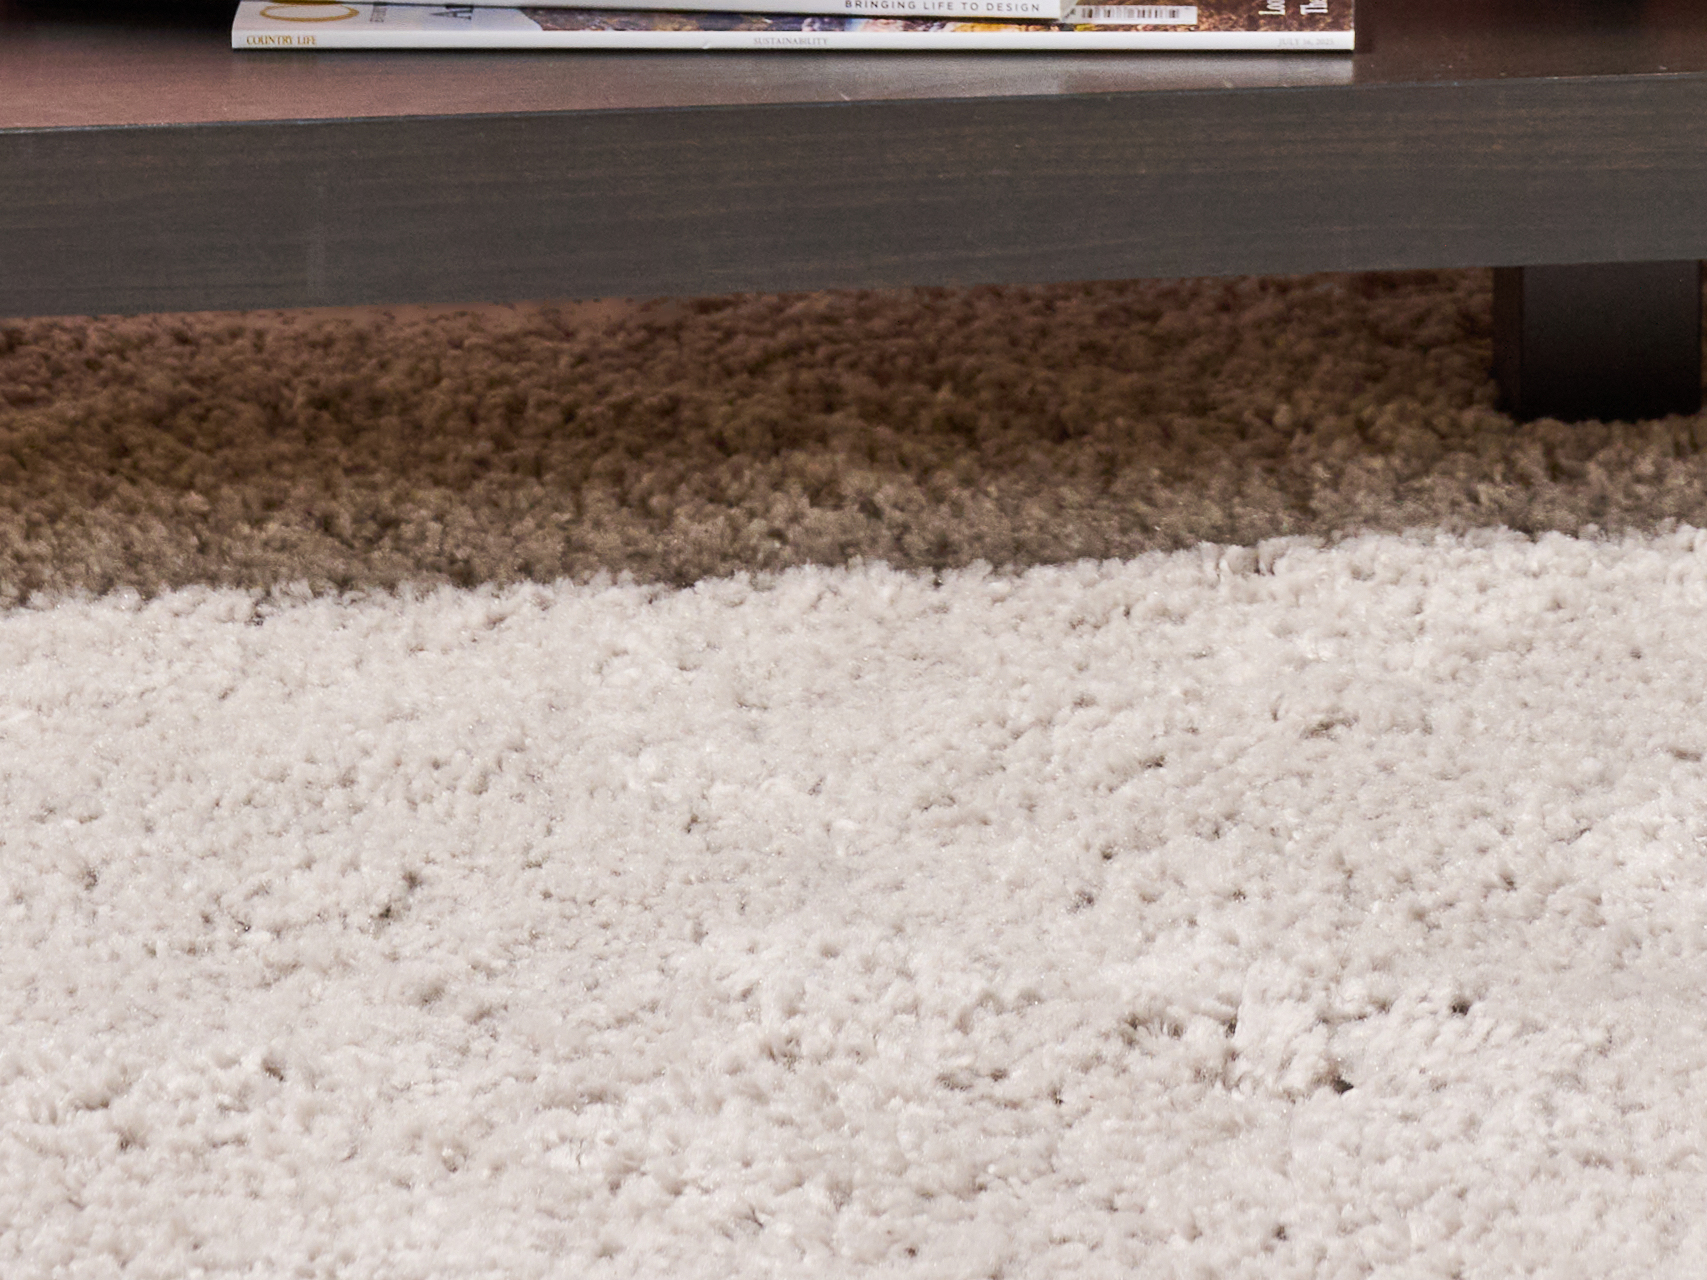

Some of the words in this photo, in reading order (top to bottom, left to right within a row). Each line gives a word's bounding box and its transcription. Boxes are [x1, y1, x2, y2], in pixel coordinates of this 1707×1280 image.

[844, 0, 916, 10] BRINGING
[923, 1, 954, 11] LIFE
[961, 2, 979, 11] TO
[986, 2, 1041, 12] DESIGN
[246, 35, 294, 45] COUNTRY
[297, 35, 317, 45] LIFE
[753, 37, 828, 46] SUSTAINABILITY
